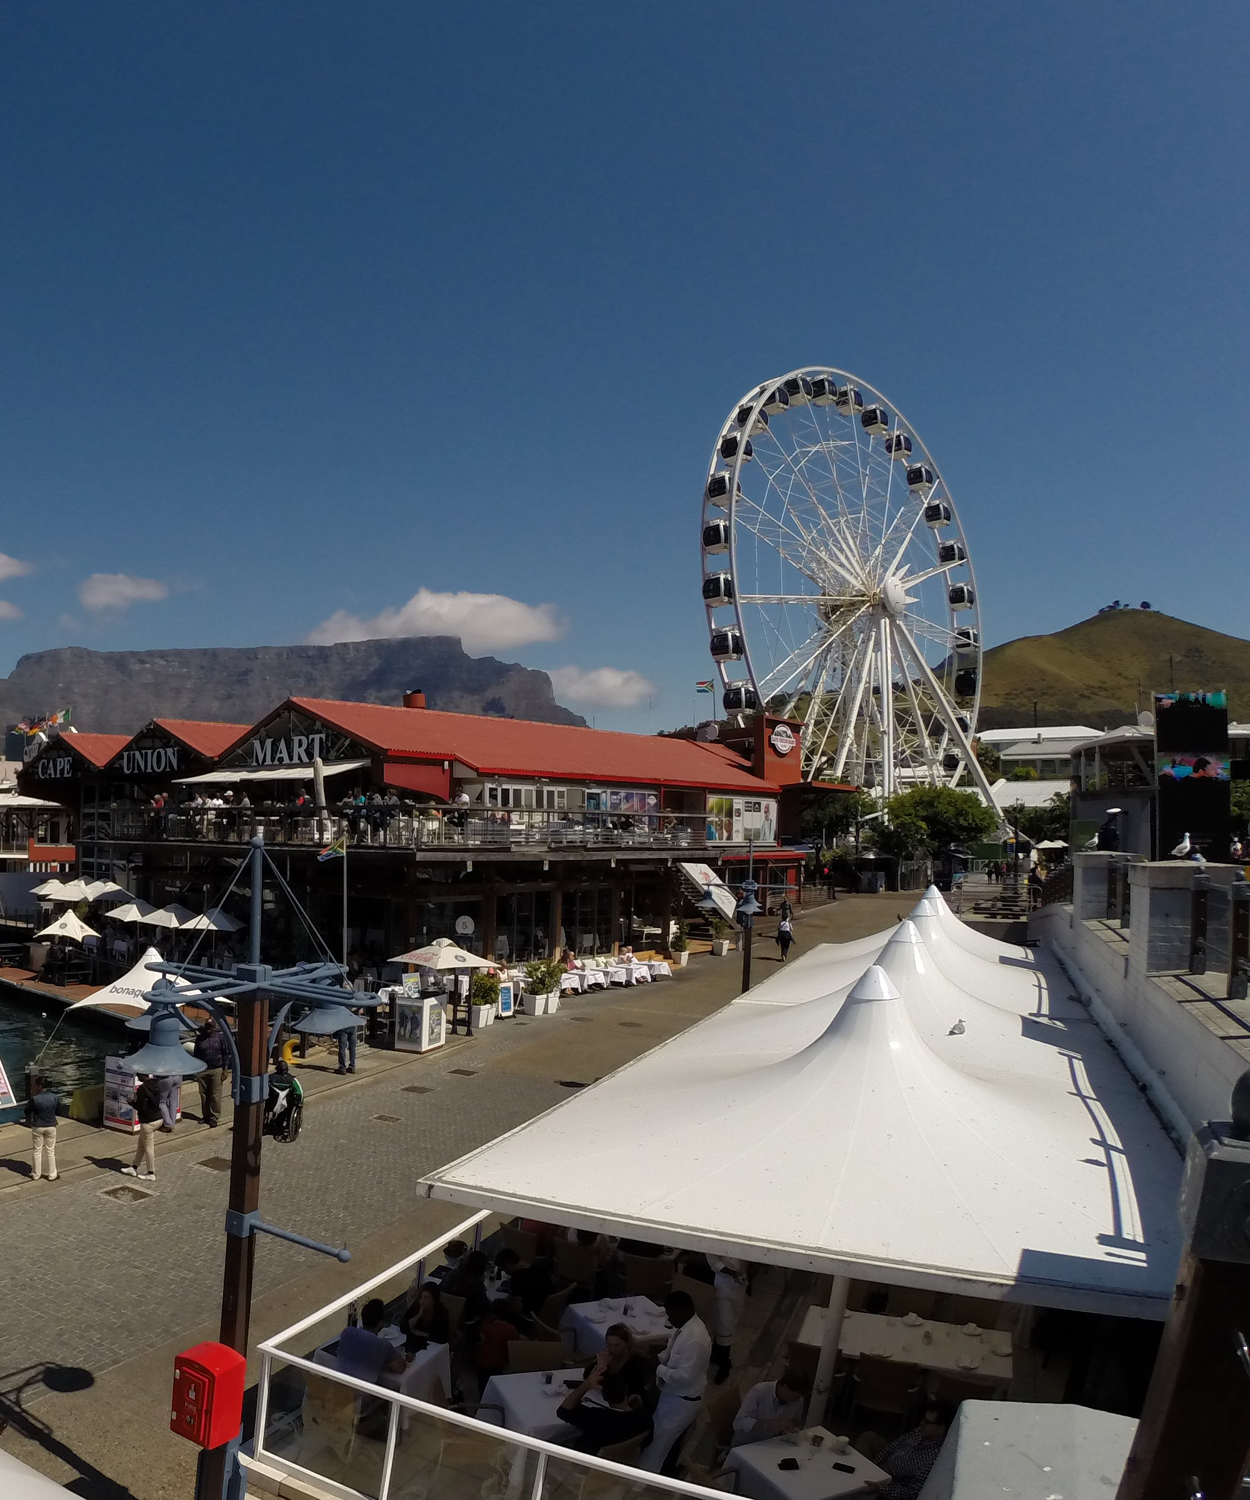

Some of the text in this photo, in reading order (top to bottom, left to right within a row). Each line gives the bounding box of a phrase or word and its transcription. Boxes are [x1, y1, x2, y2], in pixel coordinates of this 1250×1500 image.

[38, 734, 326, 779] CAPE UNION MART
[109, 985, 144, 998] bonaq
